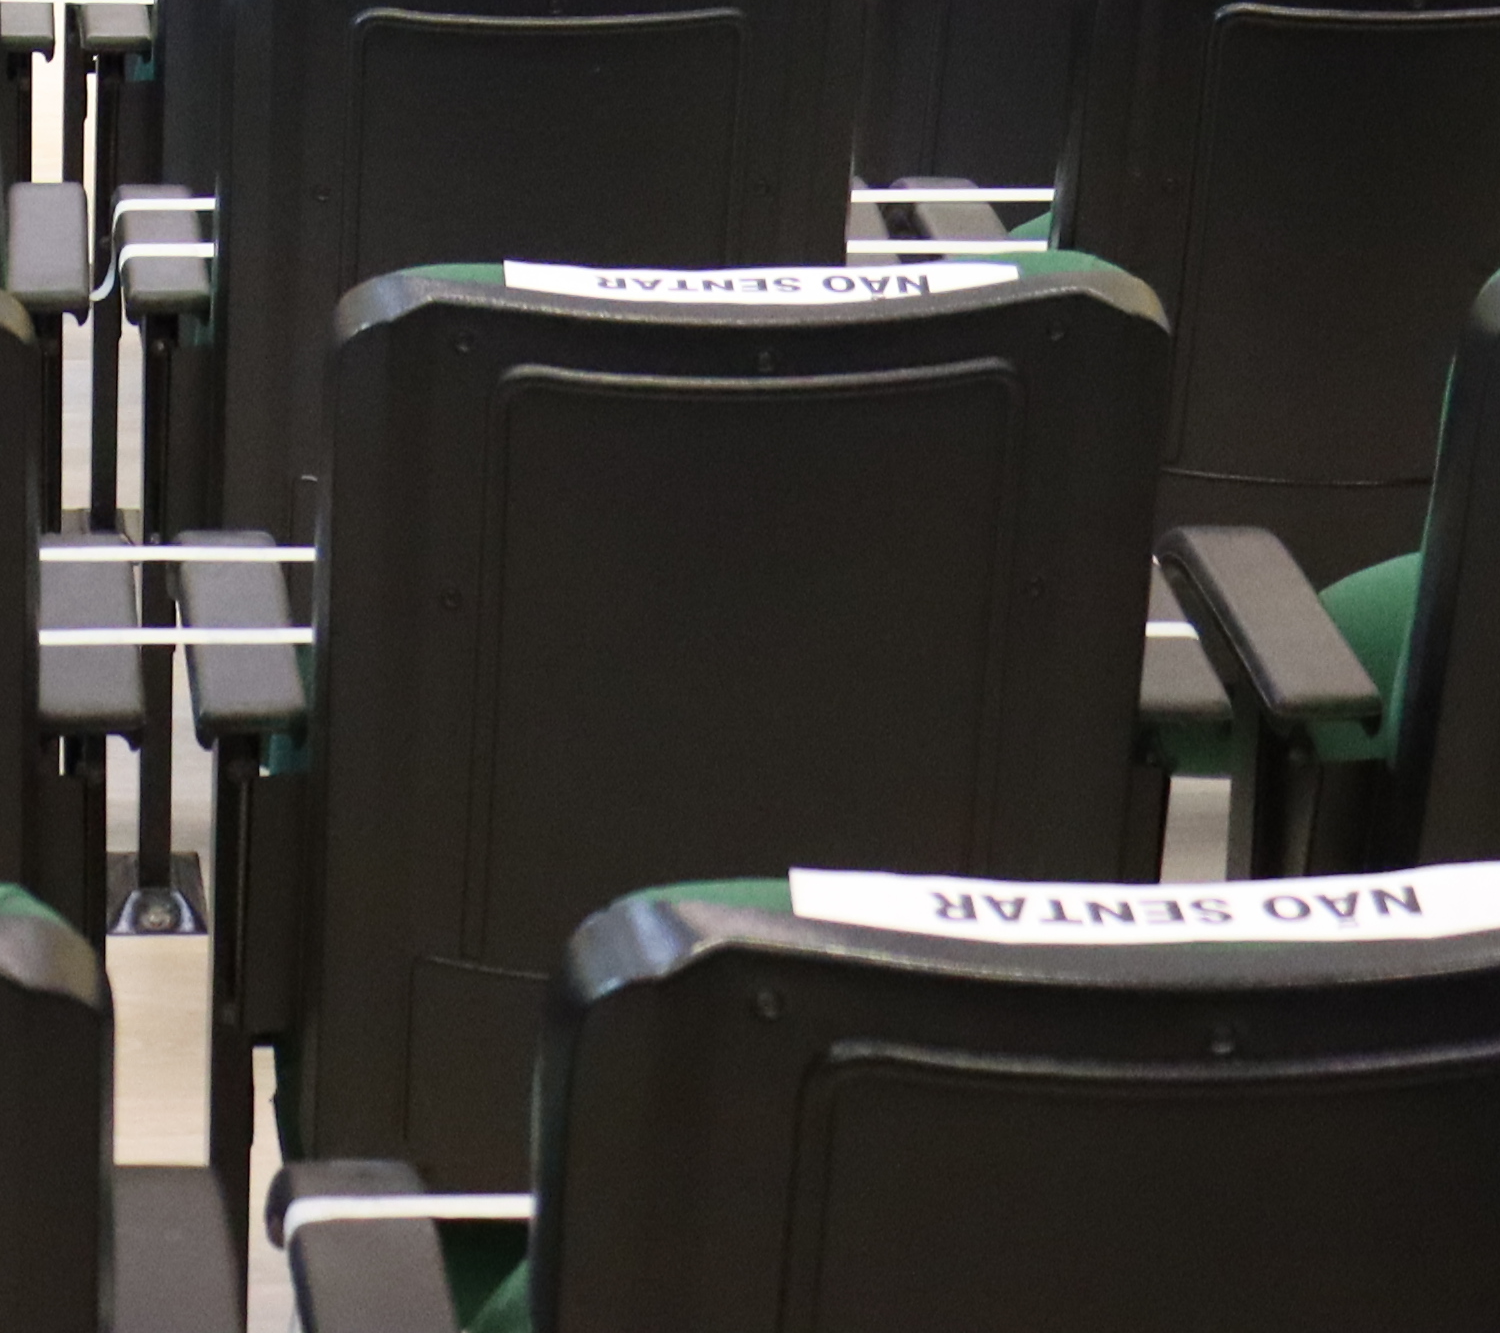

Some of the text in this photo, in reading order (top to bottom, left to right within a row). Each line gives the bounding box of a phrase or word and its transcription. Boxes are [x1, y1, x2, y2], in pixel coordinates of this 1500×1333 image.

[596, 275, 801, 292] SENTAR
[932, 885, 1424, 928] NÃO SENTAR
